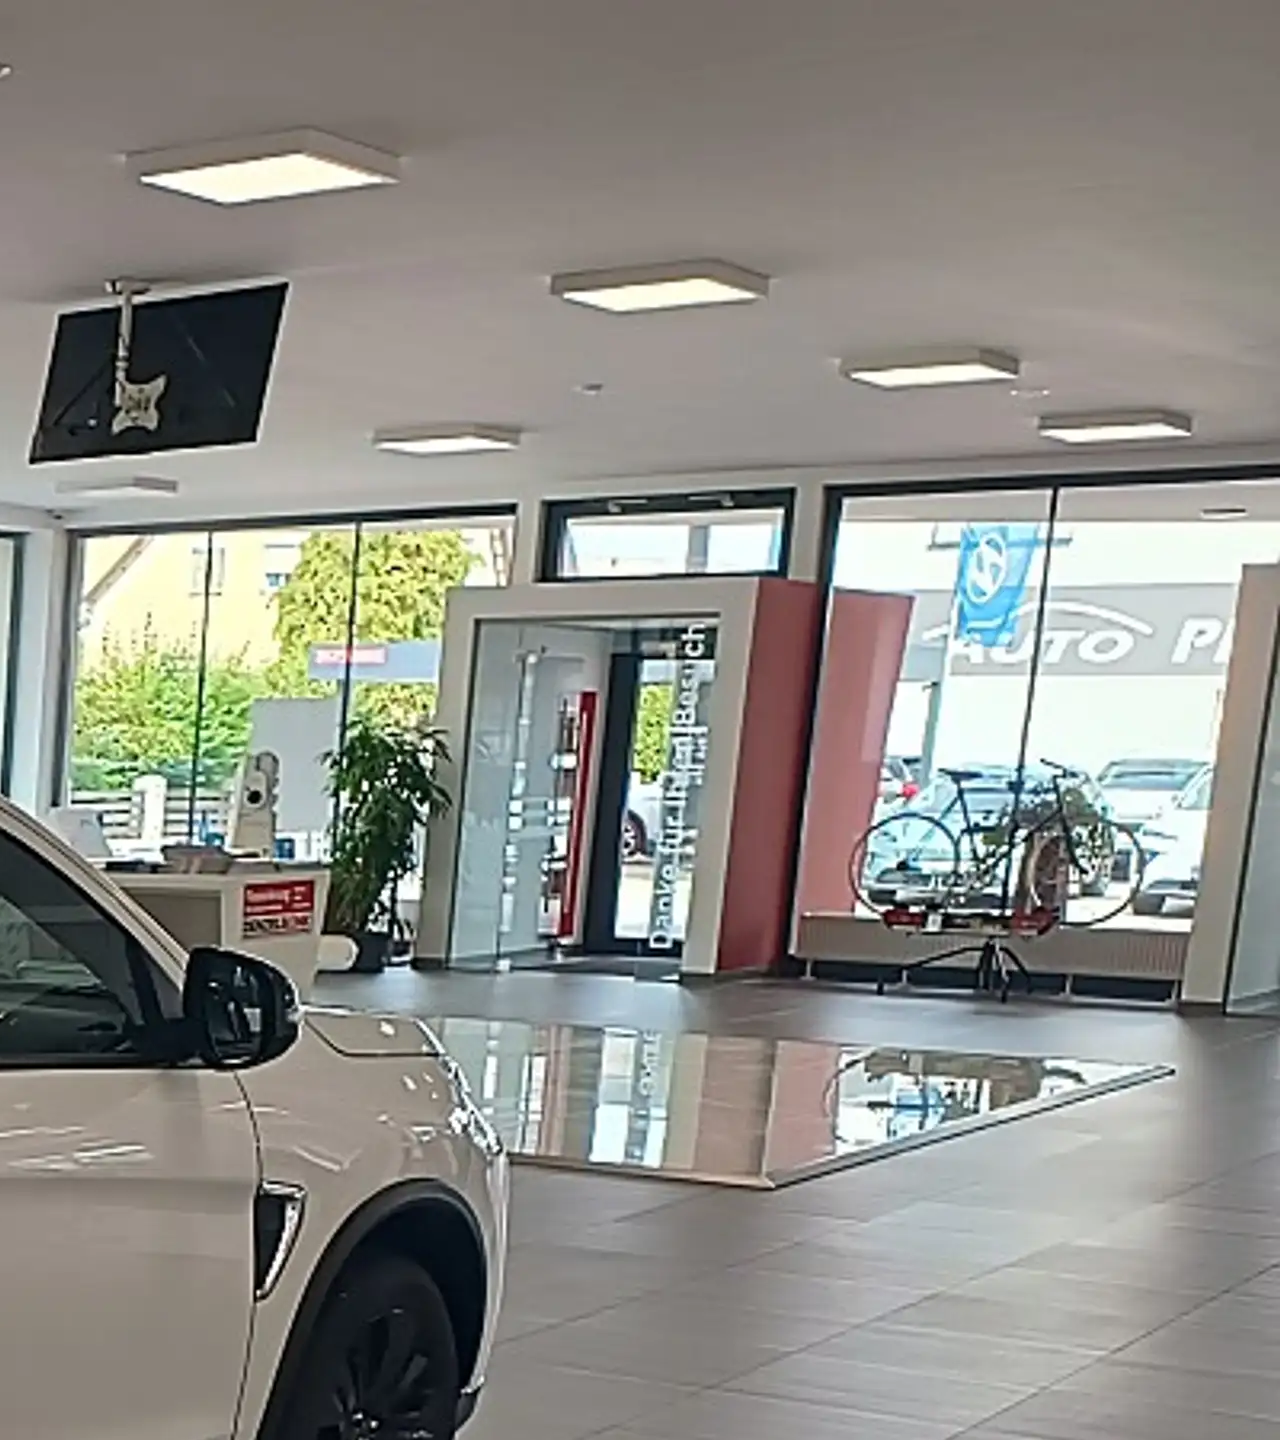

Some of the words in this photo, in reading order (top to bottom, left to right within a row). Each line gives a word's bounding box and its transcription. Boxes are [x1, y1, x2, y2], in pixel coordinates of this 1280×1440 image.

[671, 622, 706, 725] Besuch
[950, 630, 1134, 664] AUTO
[656, 813, 684, 856] für
[649, 866, 679, 949] Danke
